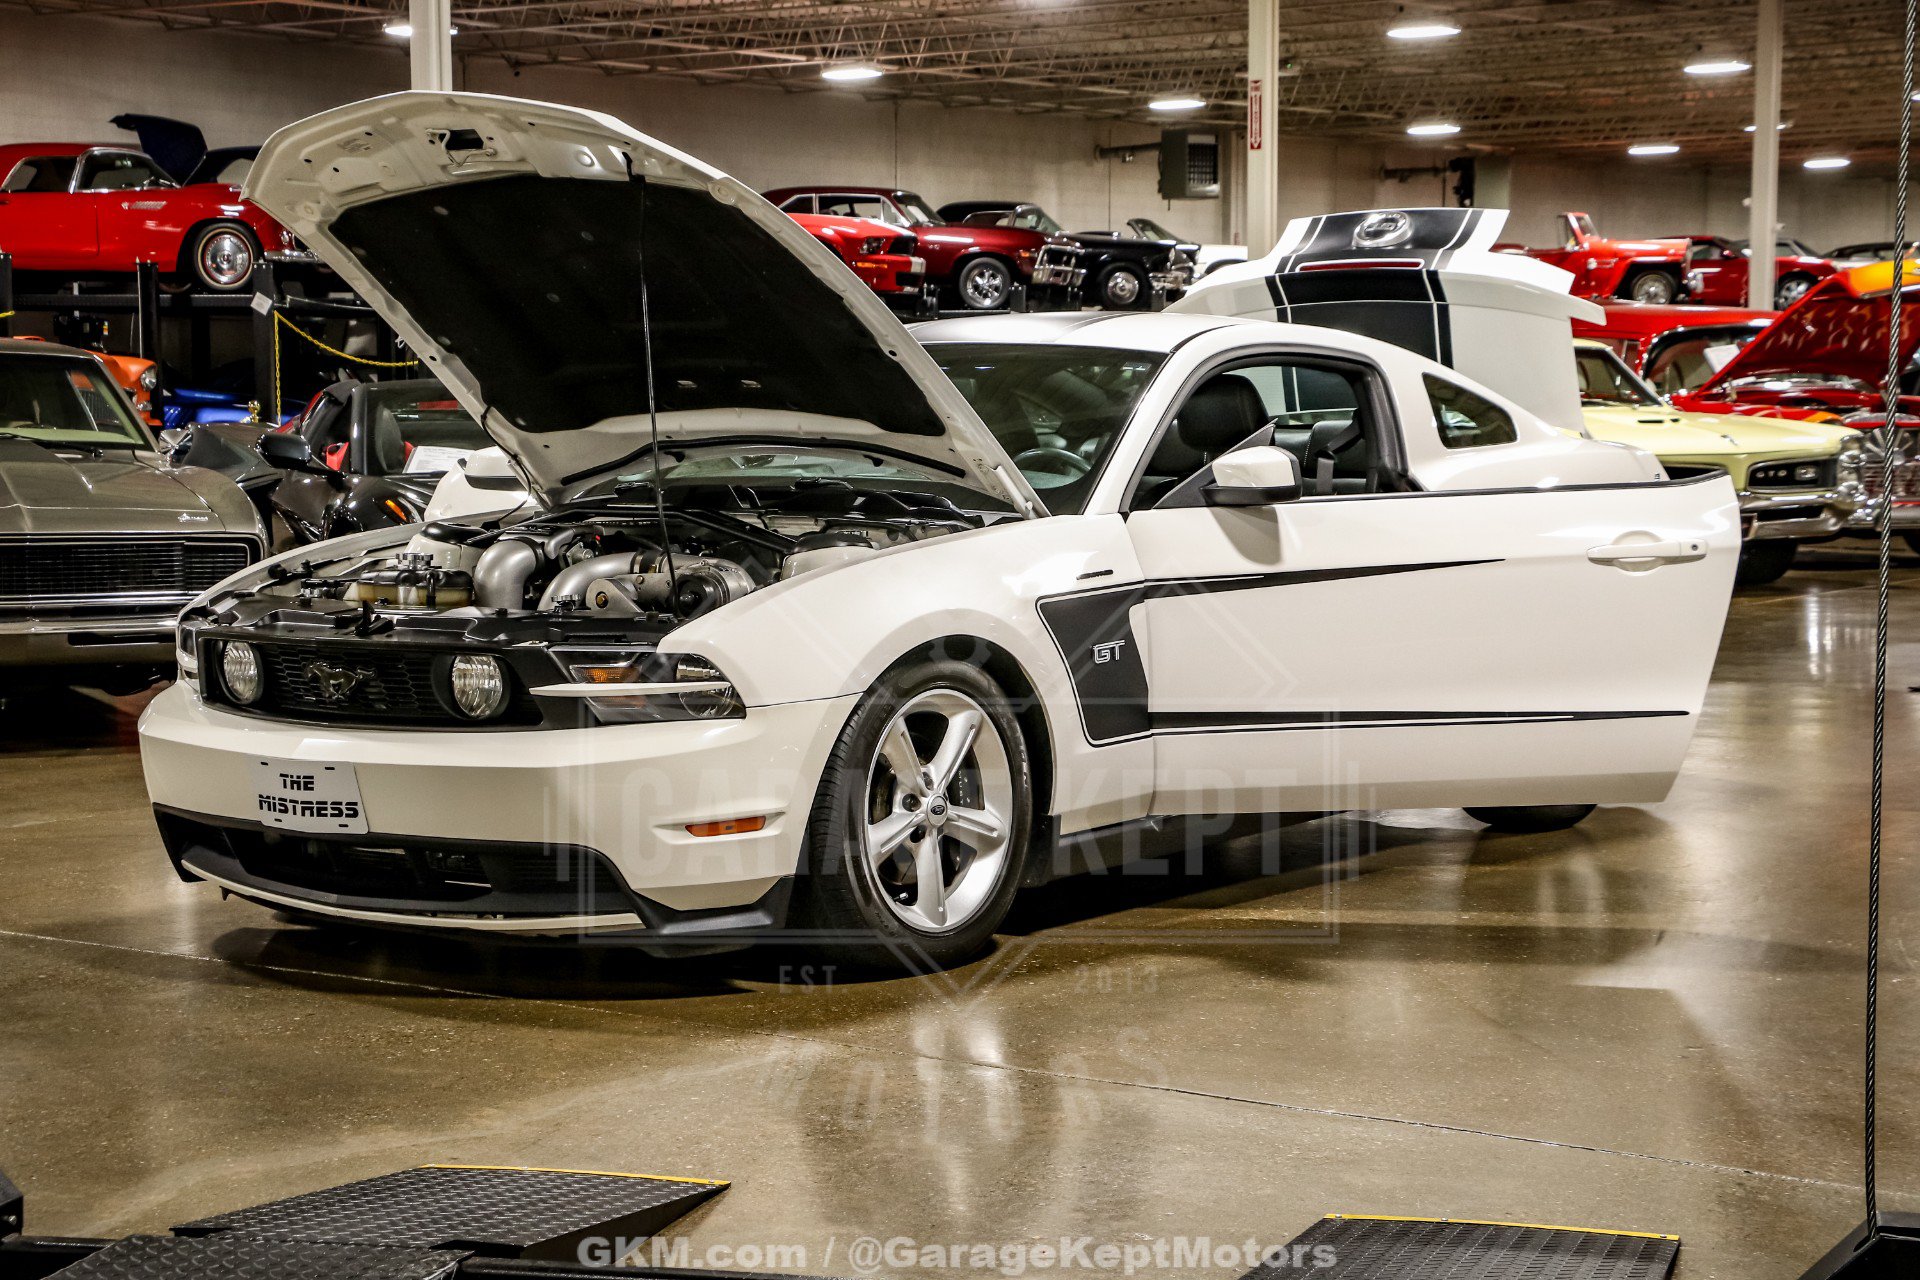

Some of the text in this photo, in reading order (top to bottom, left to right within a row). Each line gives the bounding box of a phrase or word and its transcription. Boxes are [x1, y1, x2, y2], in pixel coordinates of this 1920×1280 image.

[1093, 640, 1125, 664] GT
[279, 773, 314, 791] THE
[259, 795, 359, 818] MISTRESS
